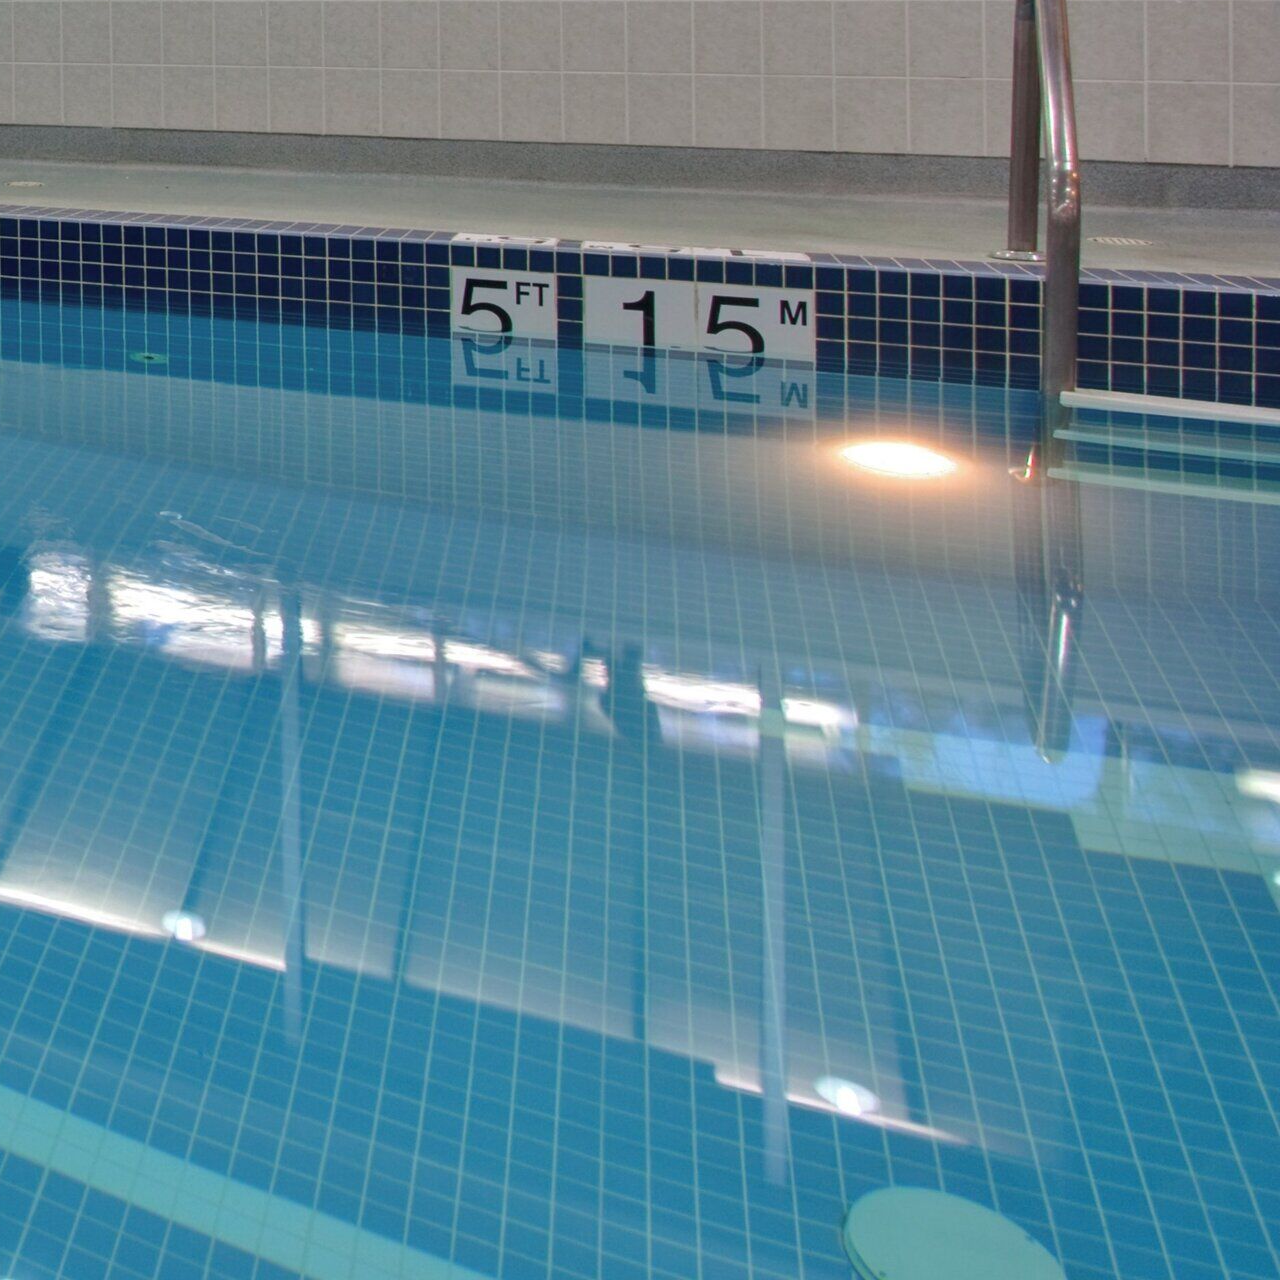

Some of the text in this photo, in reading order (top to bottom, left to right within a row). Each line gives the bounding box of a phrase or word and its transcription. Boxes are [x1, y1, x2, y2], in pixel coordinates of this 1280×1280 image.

[460, 278, 550, 333] 5 FT
[779, 300, 808, 326] M
